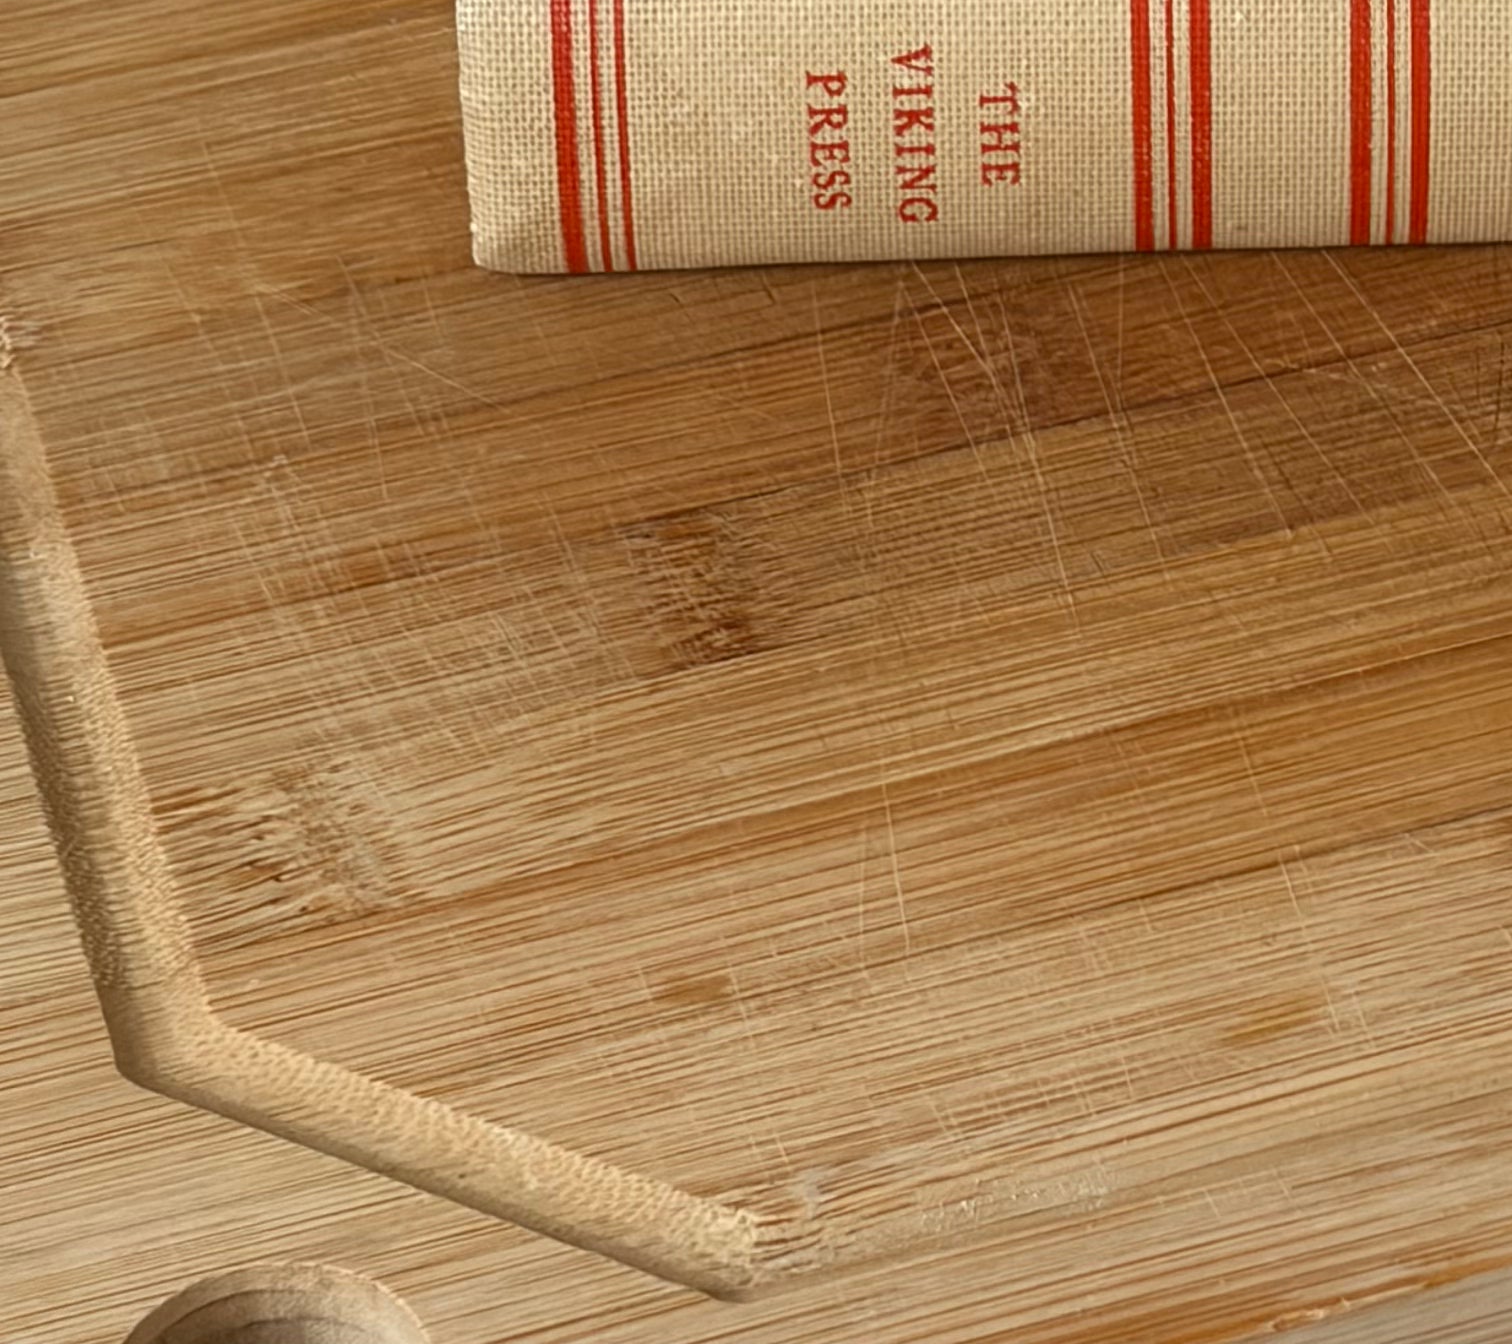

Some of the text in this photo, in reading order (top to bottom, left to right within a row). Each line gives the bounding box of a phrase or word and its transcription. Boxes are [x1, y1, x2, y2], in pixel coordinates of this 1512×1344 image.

[805, 69, 853, 213] PRESS
[890, 43, 939, 225] VIKING
[978, 81, 1022, 188] THE
